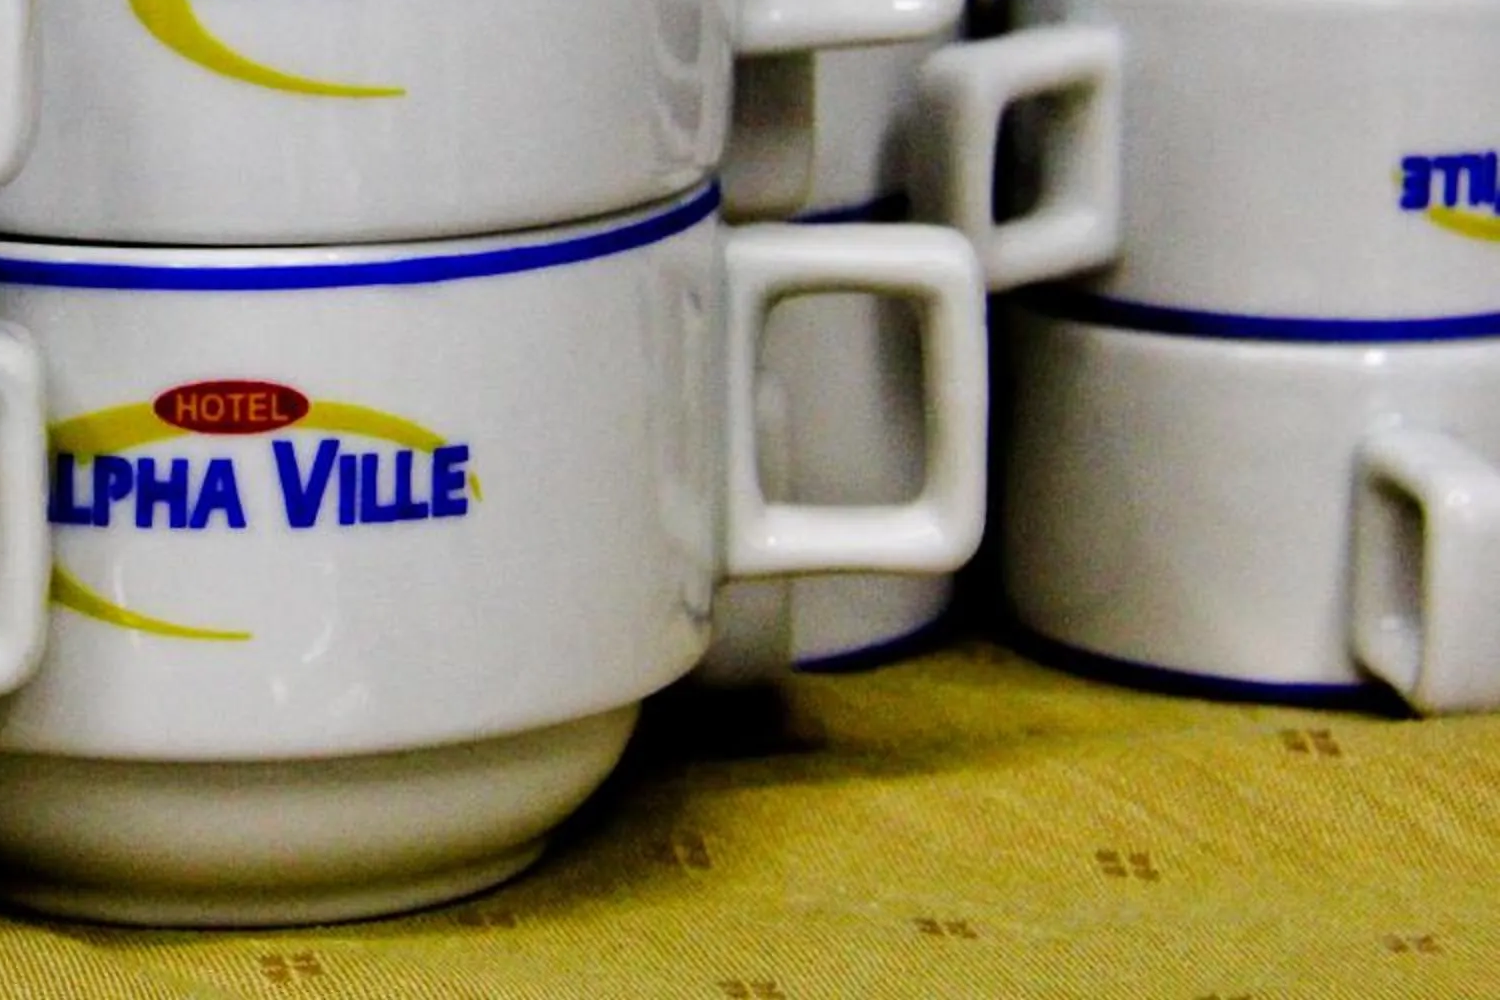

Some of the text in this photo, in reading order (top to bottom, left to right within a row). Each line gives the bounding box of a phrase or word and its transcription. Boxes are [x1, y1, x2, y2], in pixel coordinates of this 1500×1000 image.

[175, 392, 290, 423] HOTEL
[47, 438, 469, 530] LPHA VILLE
